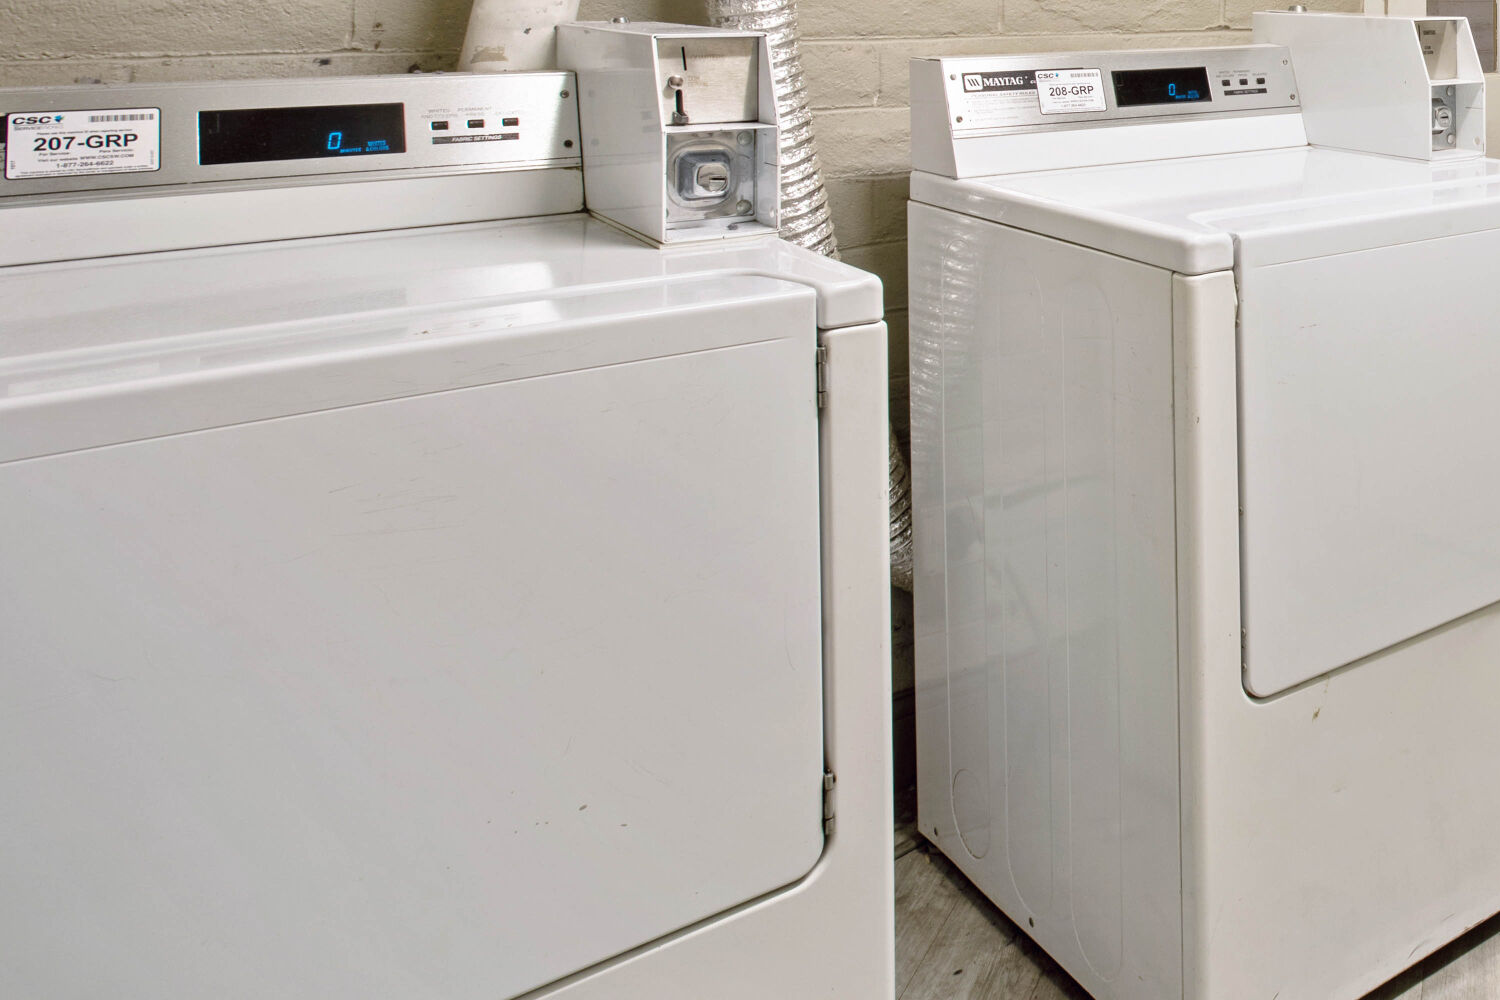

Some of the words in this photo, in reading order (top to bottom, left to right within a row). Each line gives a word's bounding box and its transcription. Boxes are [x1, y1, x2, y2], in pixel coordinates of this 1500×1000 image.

[983, 76, 1023, 86] MAYTAG
[1048, 85, 1094, 97] 208-GRP
[1168, 83, 1175, 96] 0
[12, 116, 52, 124] CSC
[33, 133, 138, 152] 207-GRP
[327, 131, 342, 149] 0
